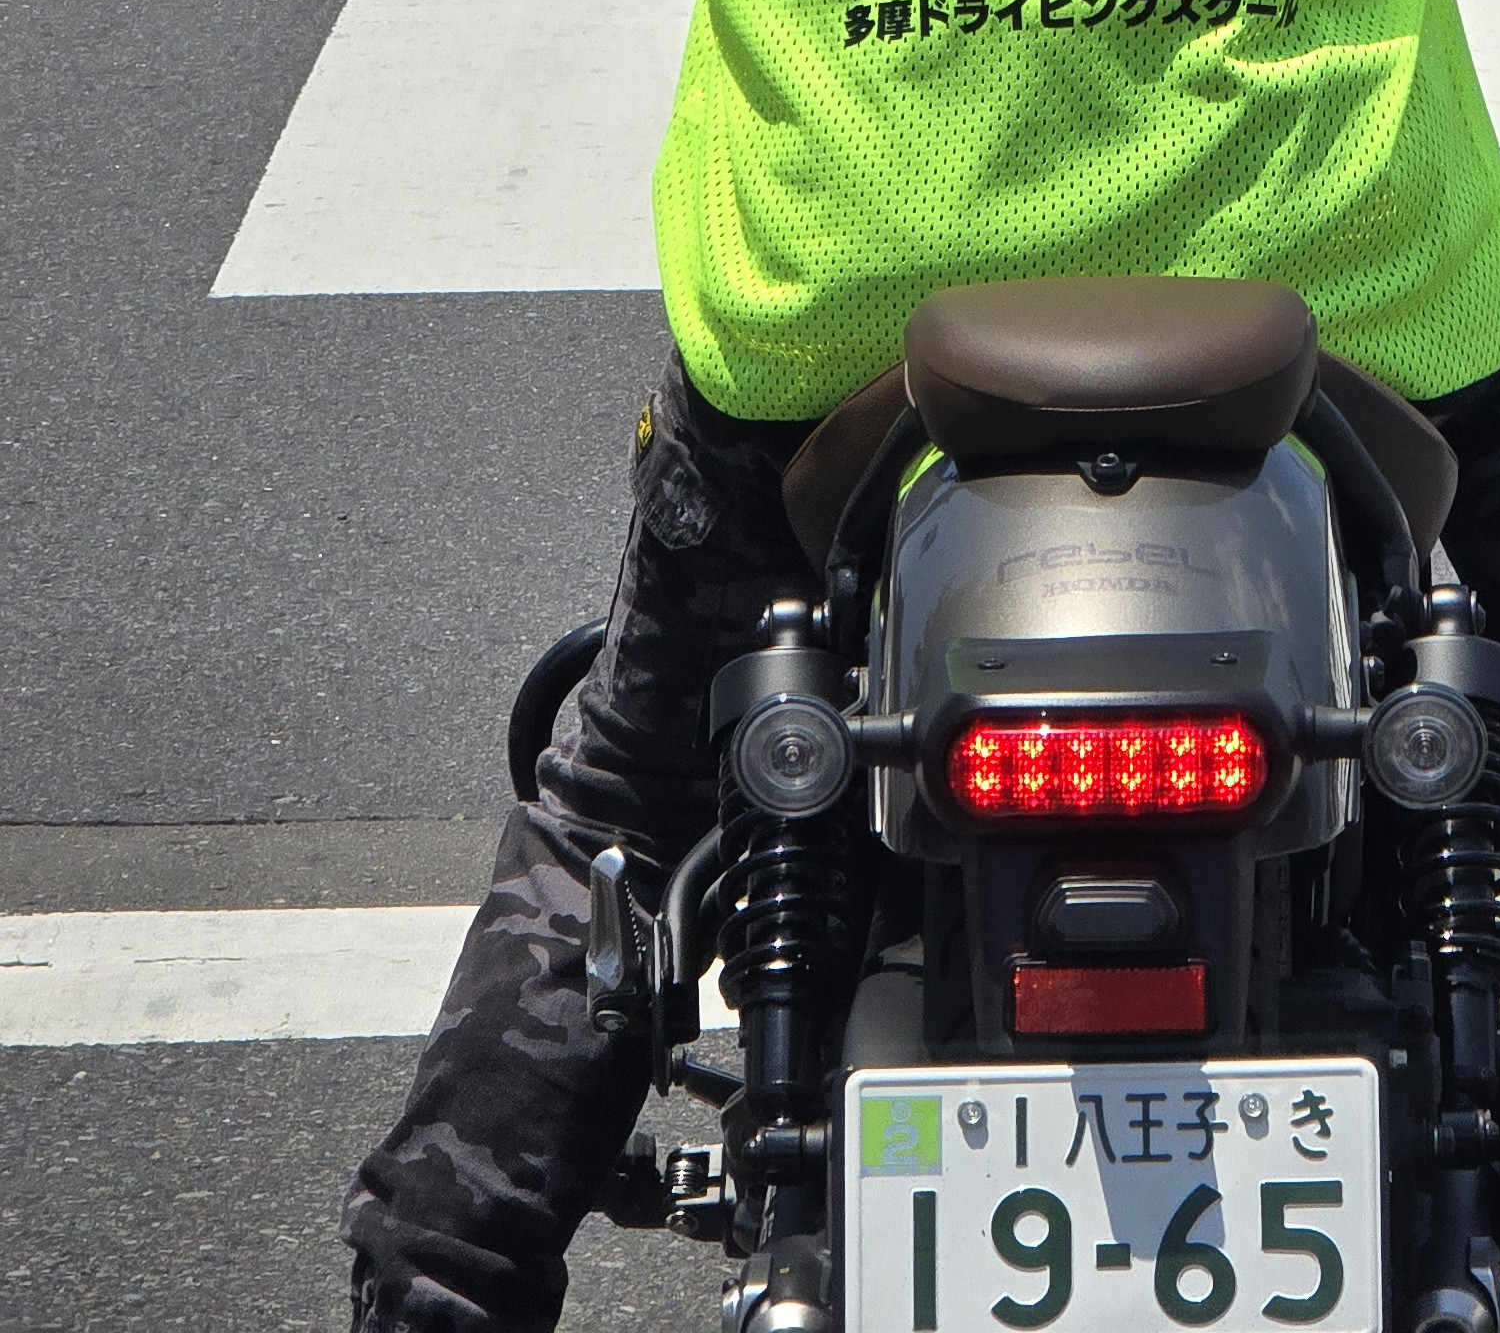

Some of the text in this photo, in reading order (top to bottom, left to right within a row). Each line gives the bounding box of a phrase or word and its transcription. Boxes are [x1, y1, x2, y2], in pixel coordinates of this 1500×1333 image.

[1040, 576, 1179, 599] HONDA
[1065, 1091, 1229, 1166] 八王子
[1290, 1089, 1334, 1160] き
[911, 1179, 1345, 1331] 19-65
